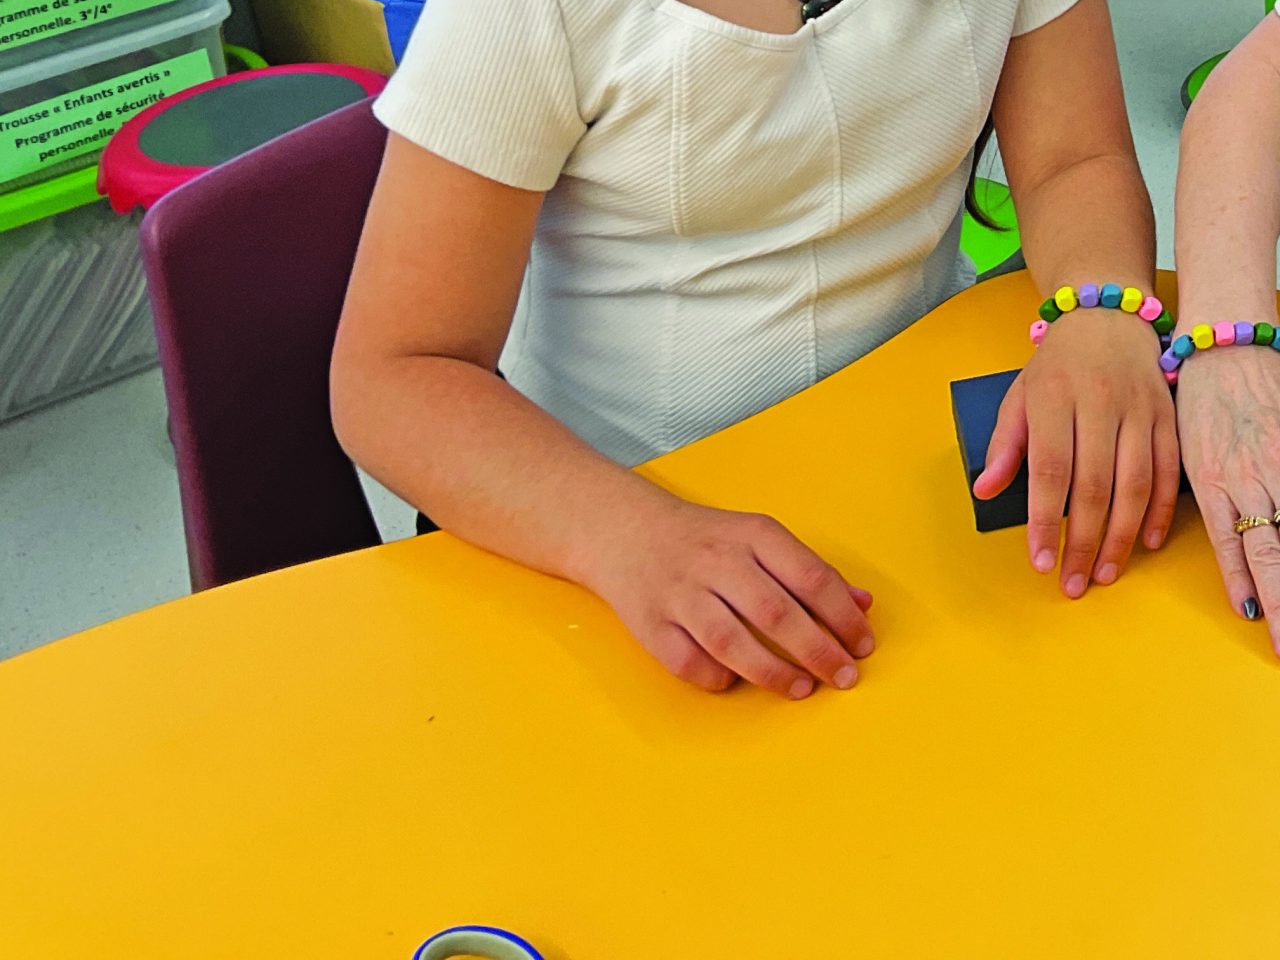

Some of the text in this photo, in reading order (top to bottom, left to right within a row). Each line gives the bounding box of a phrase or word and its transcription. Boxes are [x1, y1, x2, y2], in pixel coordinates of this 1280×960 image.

[0, 5, 48, 25] ramme
[0, 18, 76, 44] ersonnelle.
[0, 110, 49, 132] Trousse
[64, 88, 114, 110] Enfants
[117, 73, 160, 93] avertis
[15, 90, 166, 149] Programme de sécurité
